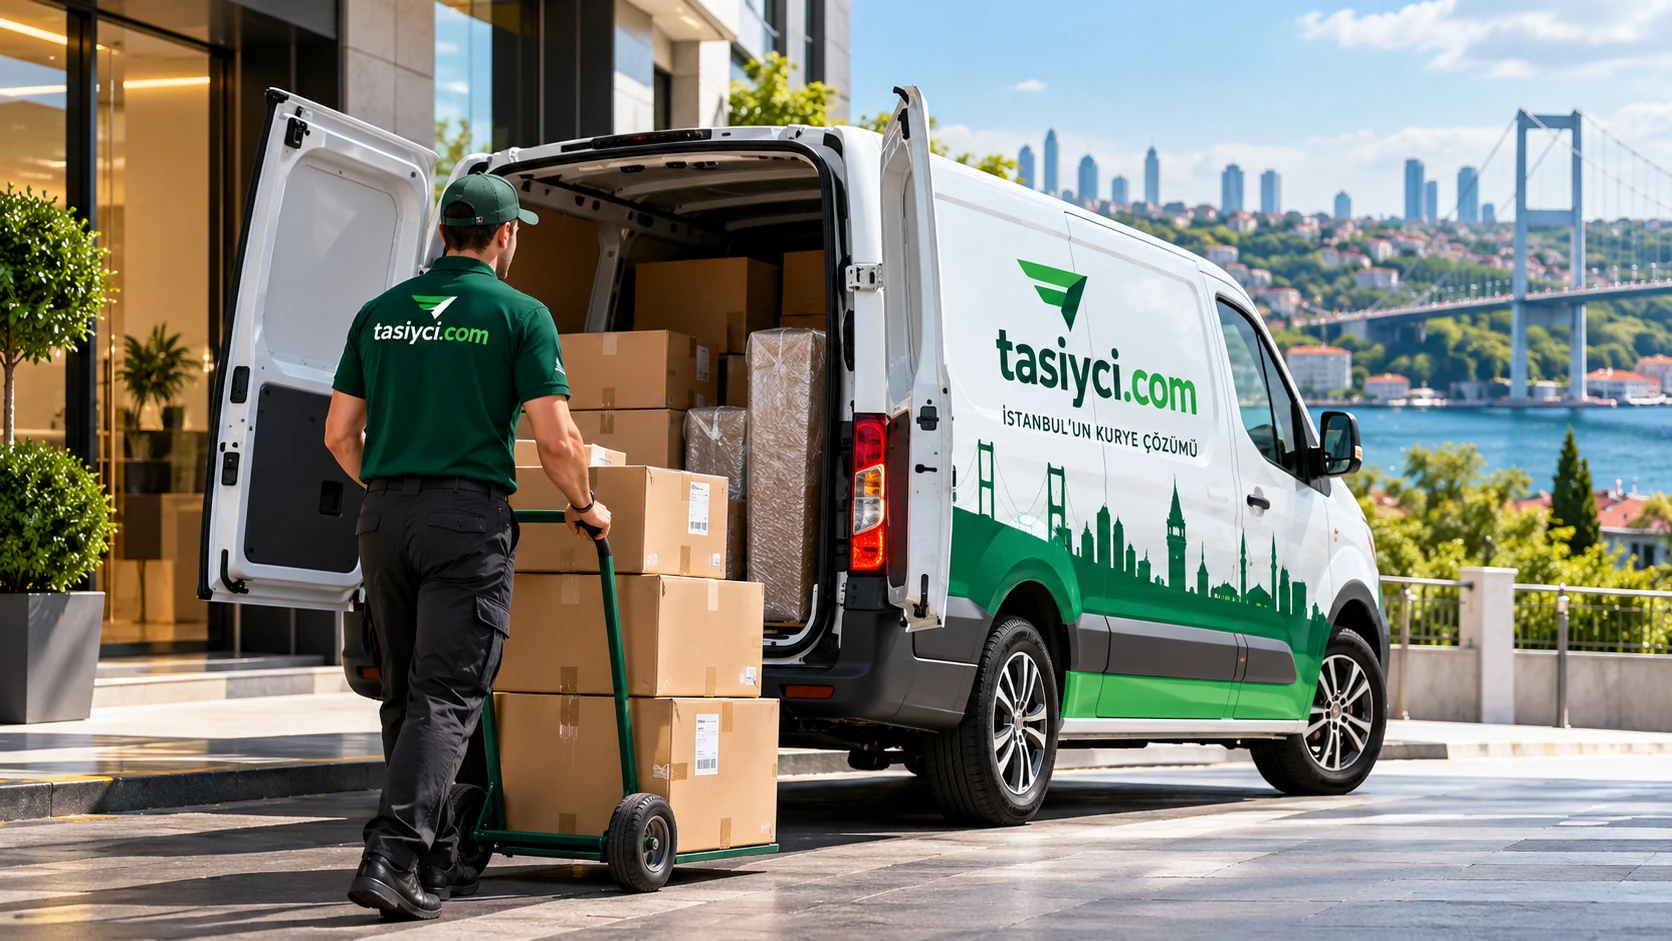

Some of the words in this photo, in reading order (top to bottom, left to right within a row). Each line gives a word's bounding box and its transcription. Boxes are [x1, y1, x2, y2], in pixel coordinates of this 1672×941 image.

[373, 320, 489, 345] tasiyci.com
[995, 328, 1198, 416] tasiyci.com
[1095, 425, 1139, 448] KURYE
